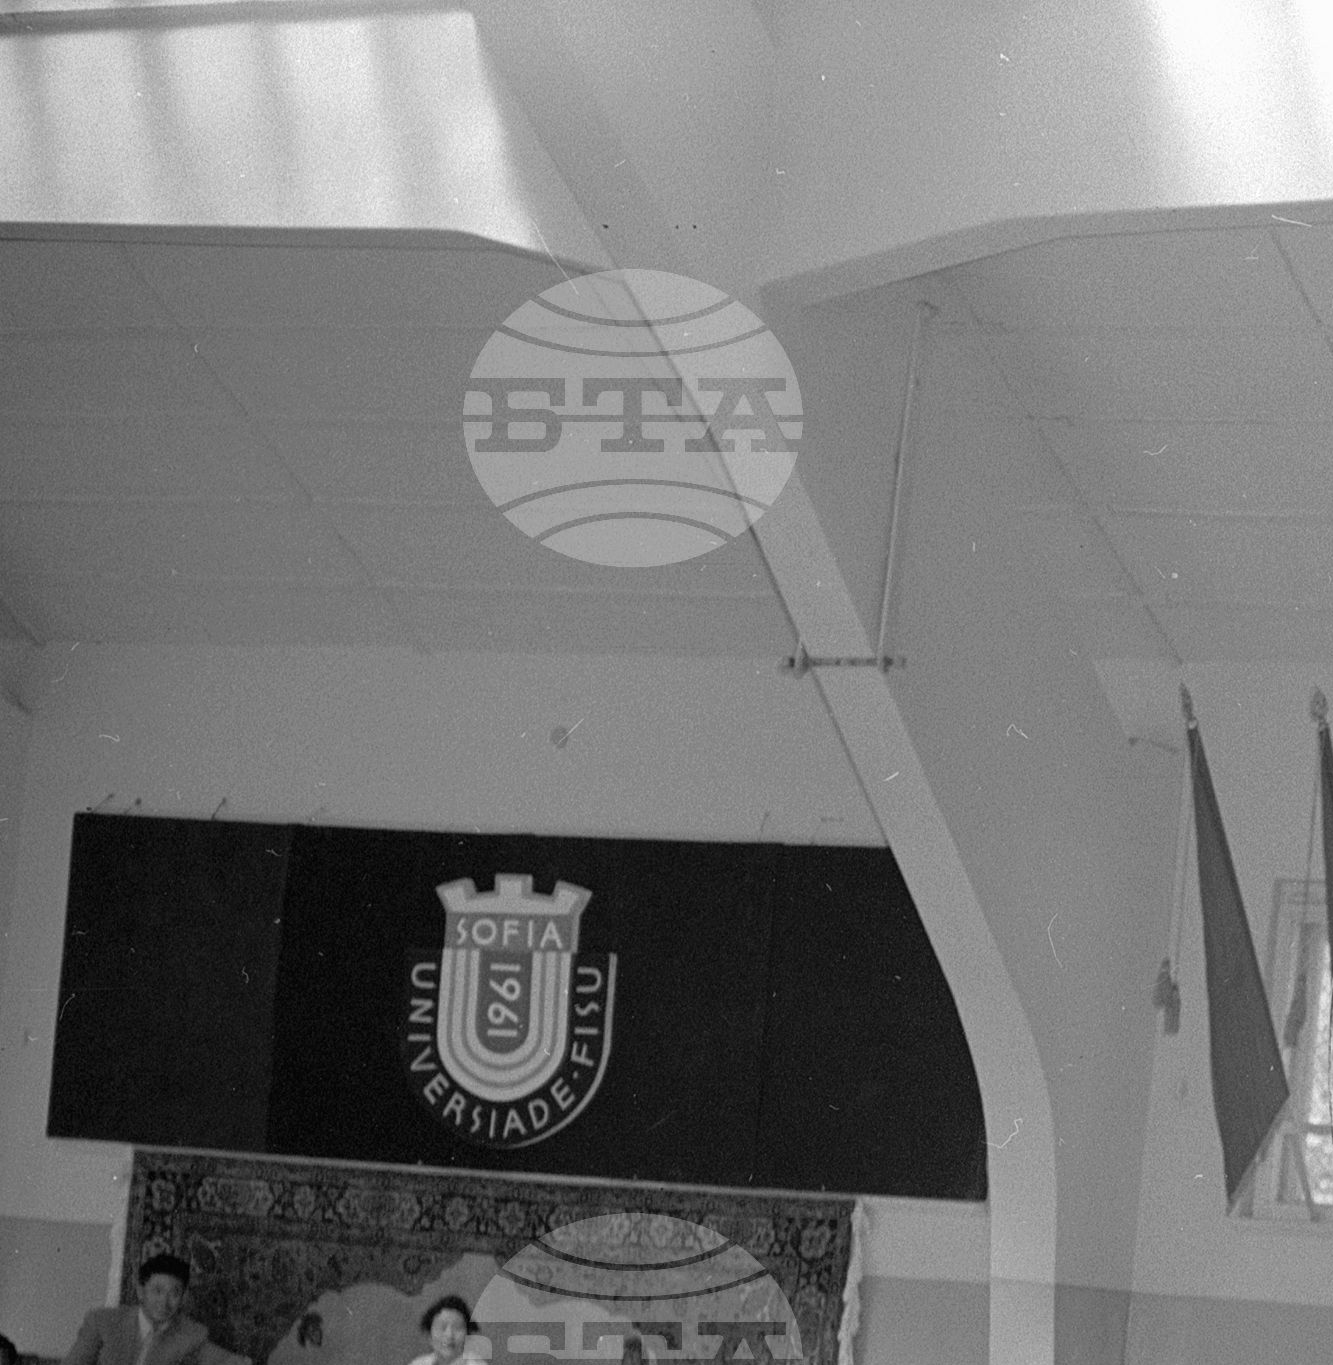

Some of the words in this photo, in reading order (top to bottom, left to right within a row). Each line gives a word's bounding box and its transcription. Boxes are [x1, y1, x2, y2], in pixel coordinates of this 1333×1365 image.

[457, 918, 563, 949] SOFIA
[487, 962, 521, 1038] 1961
[407, 962, 576, 1139] UNIVERSIADE
[571, 966, 601, 1067] FISU
